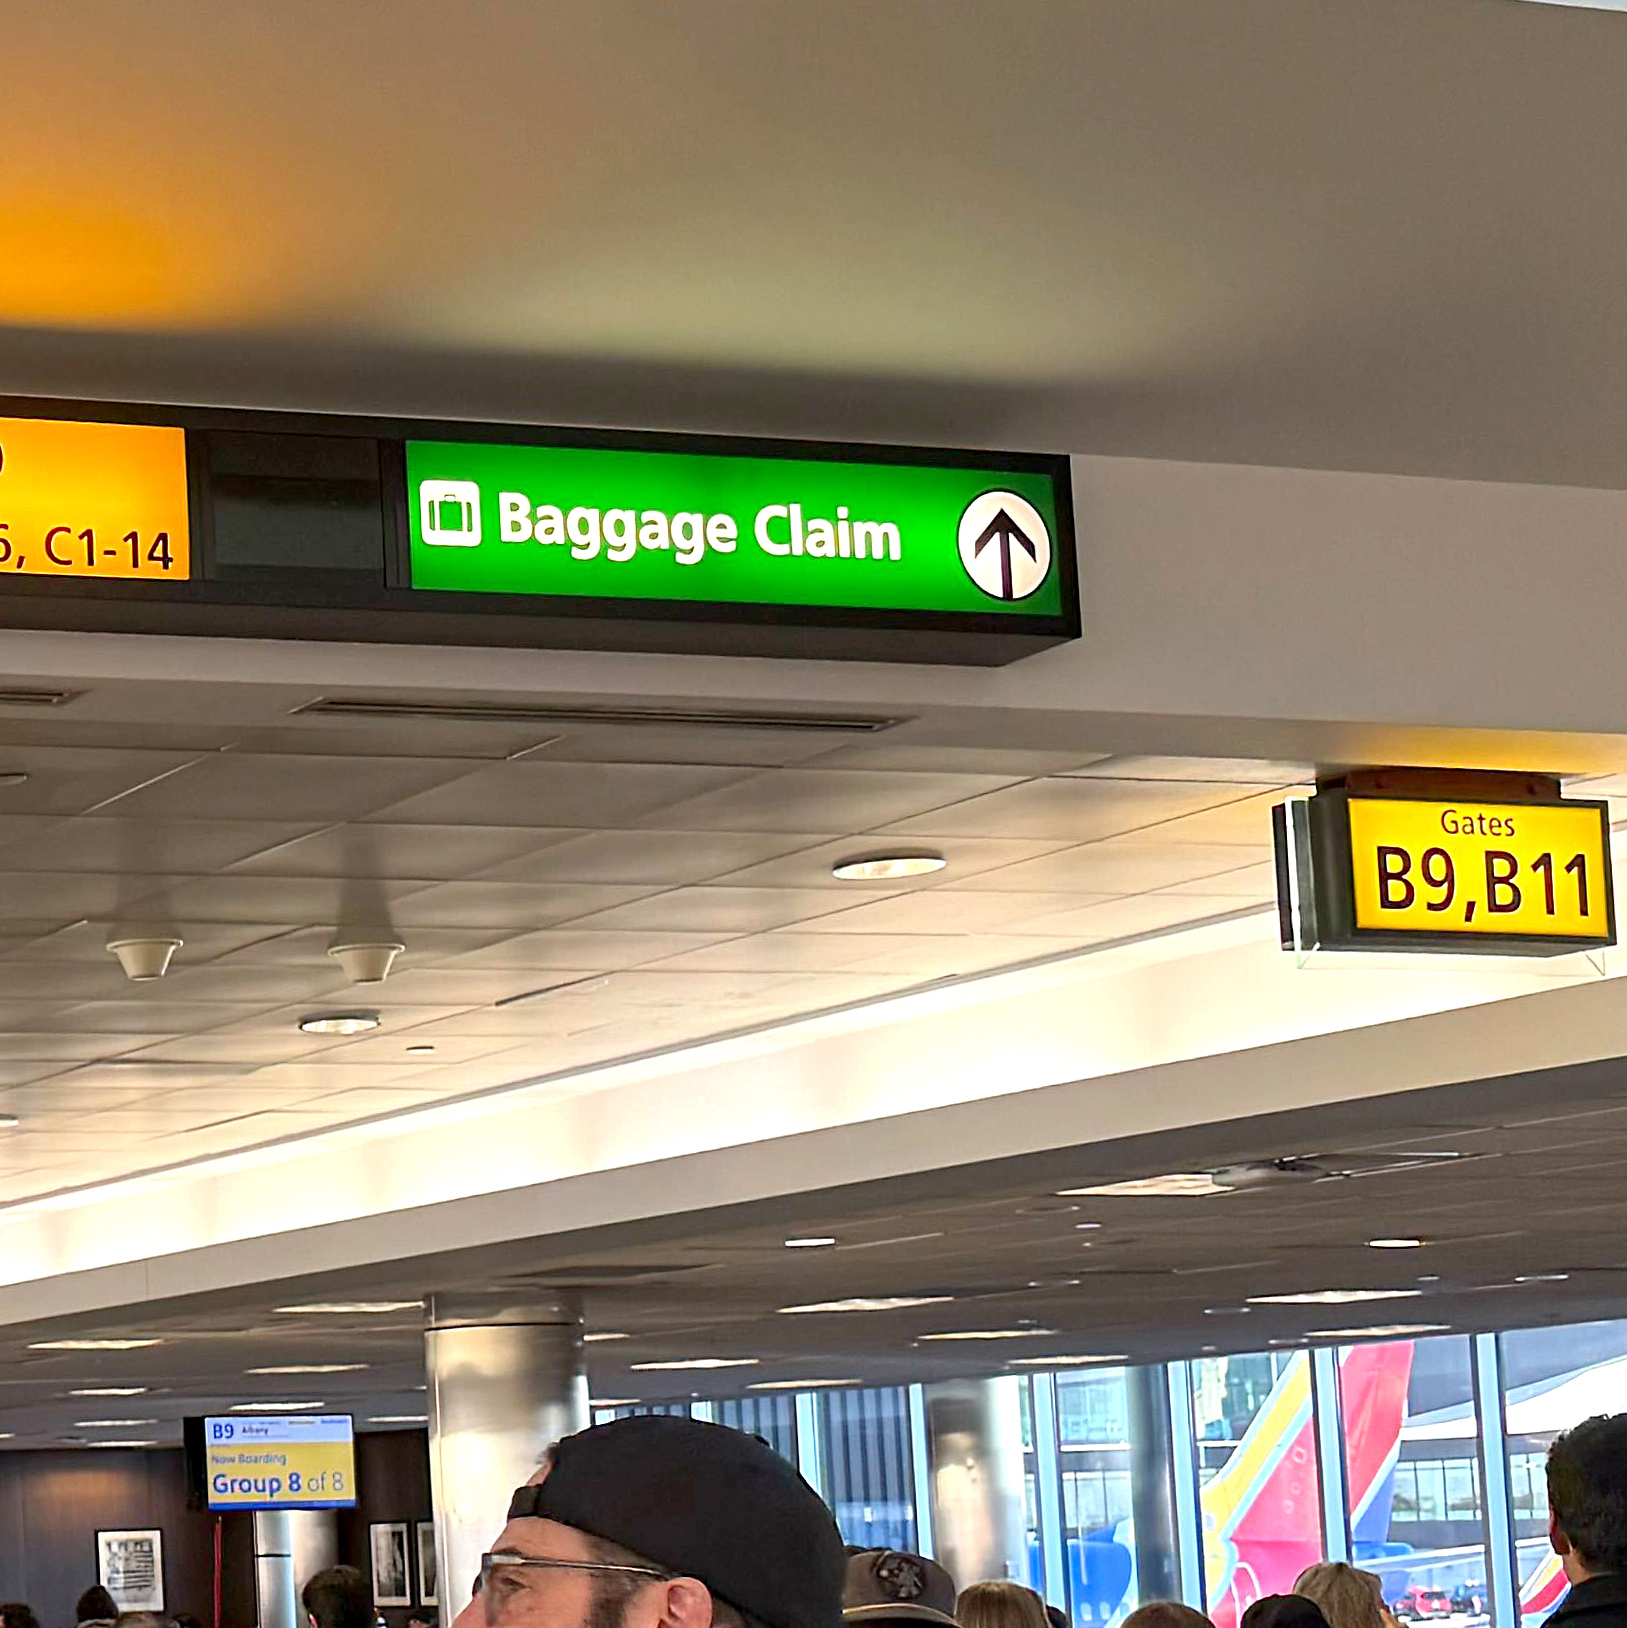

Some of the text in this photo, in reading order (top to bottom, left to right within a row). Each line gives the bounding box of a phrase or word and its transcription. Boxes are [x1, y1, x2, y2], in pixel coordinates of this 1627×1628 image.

[498, 491, 902, 565] Baggage Claim
[44, 526, 175, 571] C1-14
[1440, 809, 1516, 838] Gates
[1376, 845, 1589, 923] B9,B11
[213, 1423, 234, 1439] B9
[211, 1453, 286, 1466] Now Boarding
[213, 1472, 343, 1497] Group 8 of 8
